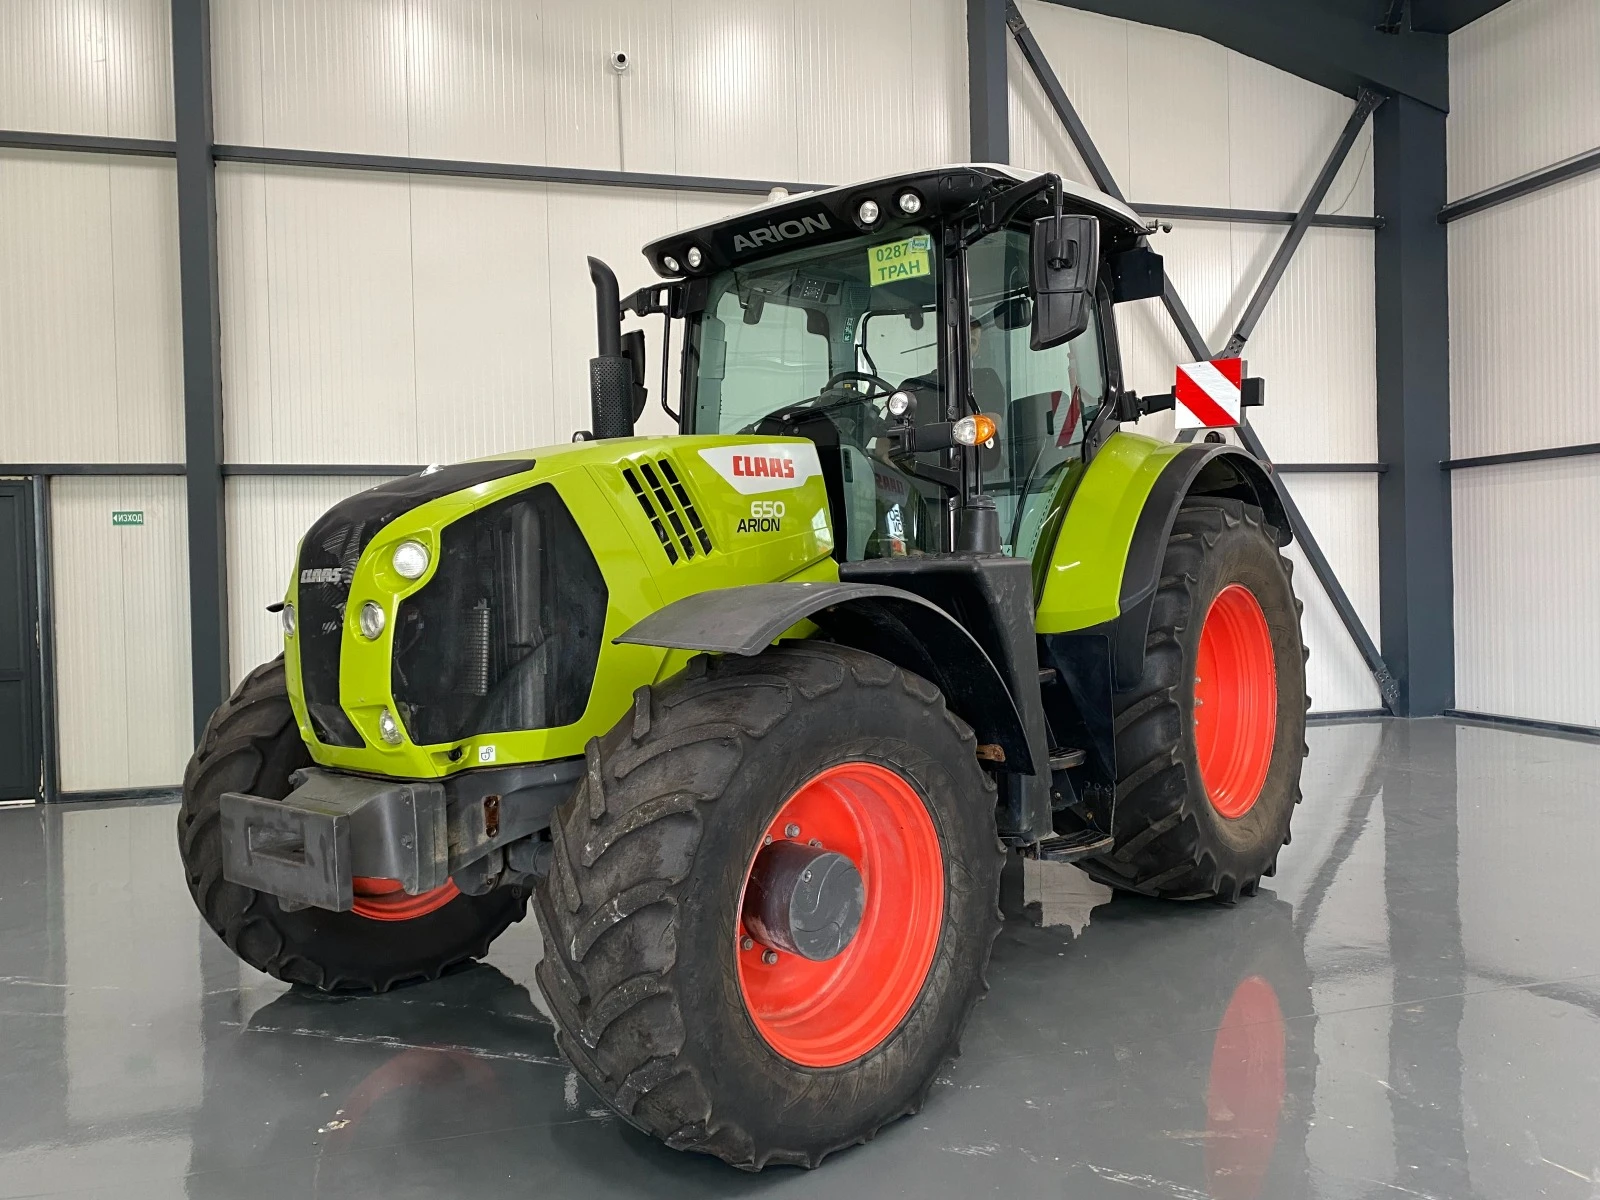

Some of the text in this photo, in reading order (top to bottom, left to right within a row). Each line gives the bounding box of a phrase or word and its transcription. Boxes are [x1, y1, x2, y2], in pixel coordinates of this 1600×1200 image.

[733, 212, 832, 252] ARION
[732, 455, 795, 479] CLAAS
[750, 500, 786, 518] 650
[118, 513, 143, 524] ИЗХОД
[736, 518, 781, 533] ARION
[300, 567, 343, 584] CLAAS
